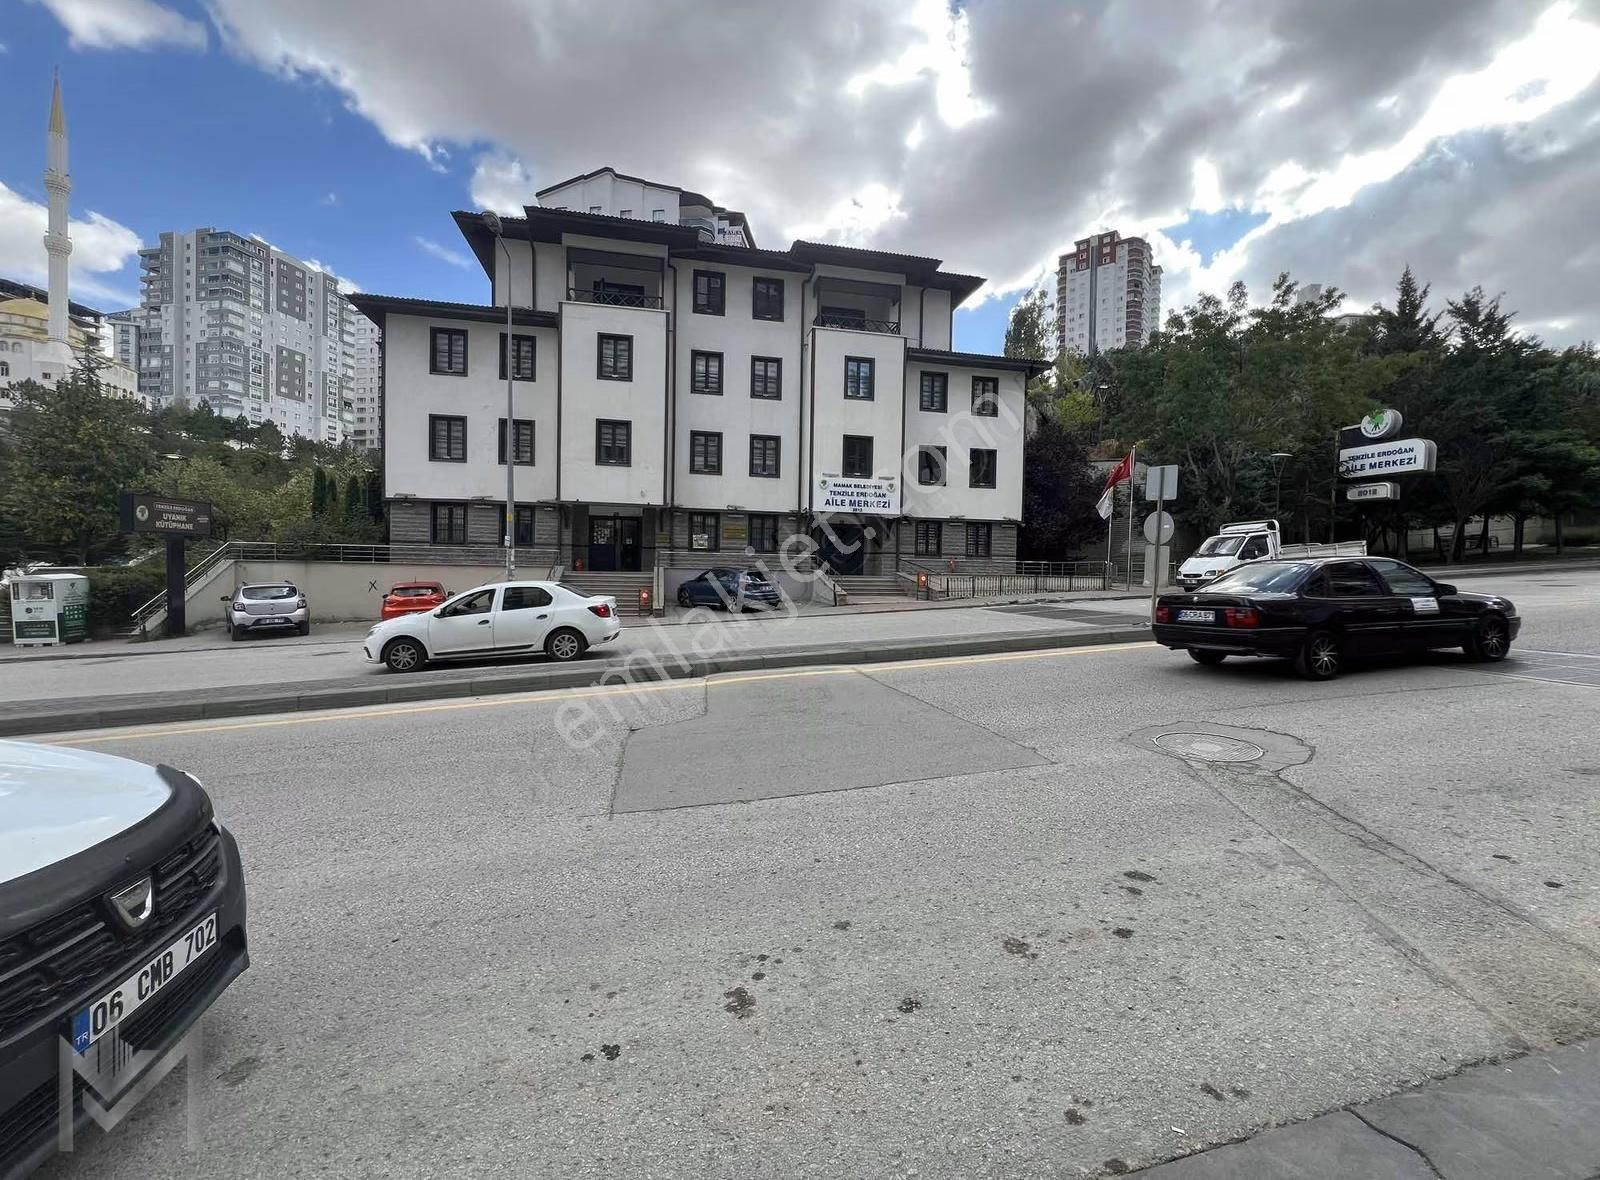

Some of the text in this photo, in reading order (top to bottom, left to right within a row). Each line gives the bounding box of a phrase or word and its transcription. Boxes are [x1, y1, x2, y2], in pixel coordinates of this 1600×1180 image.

[1377, 448, 1414, 458] ERDOĞAN
[1369, 455, 1417, 470] MERKEZİ
[825, 498, 890, 508] AİLE MERKEZİ
[92, 918, 216, 1036] 06 CMB 702
[75, 1032, 89, 1046] TR
